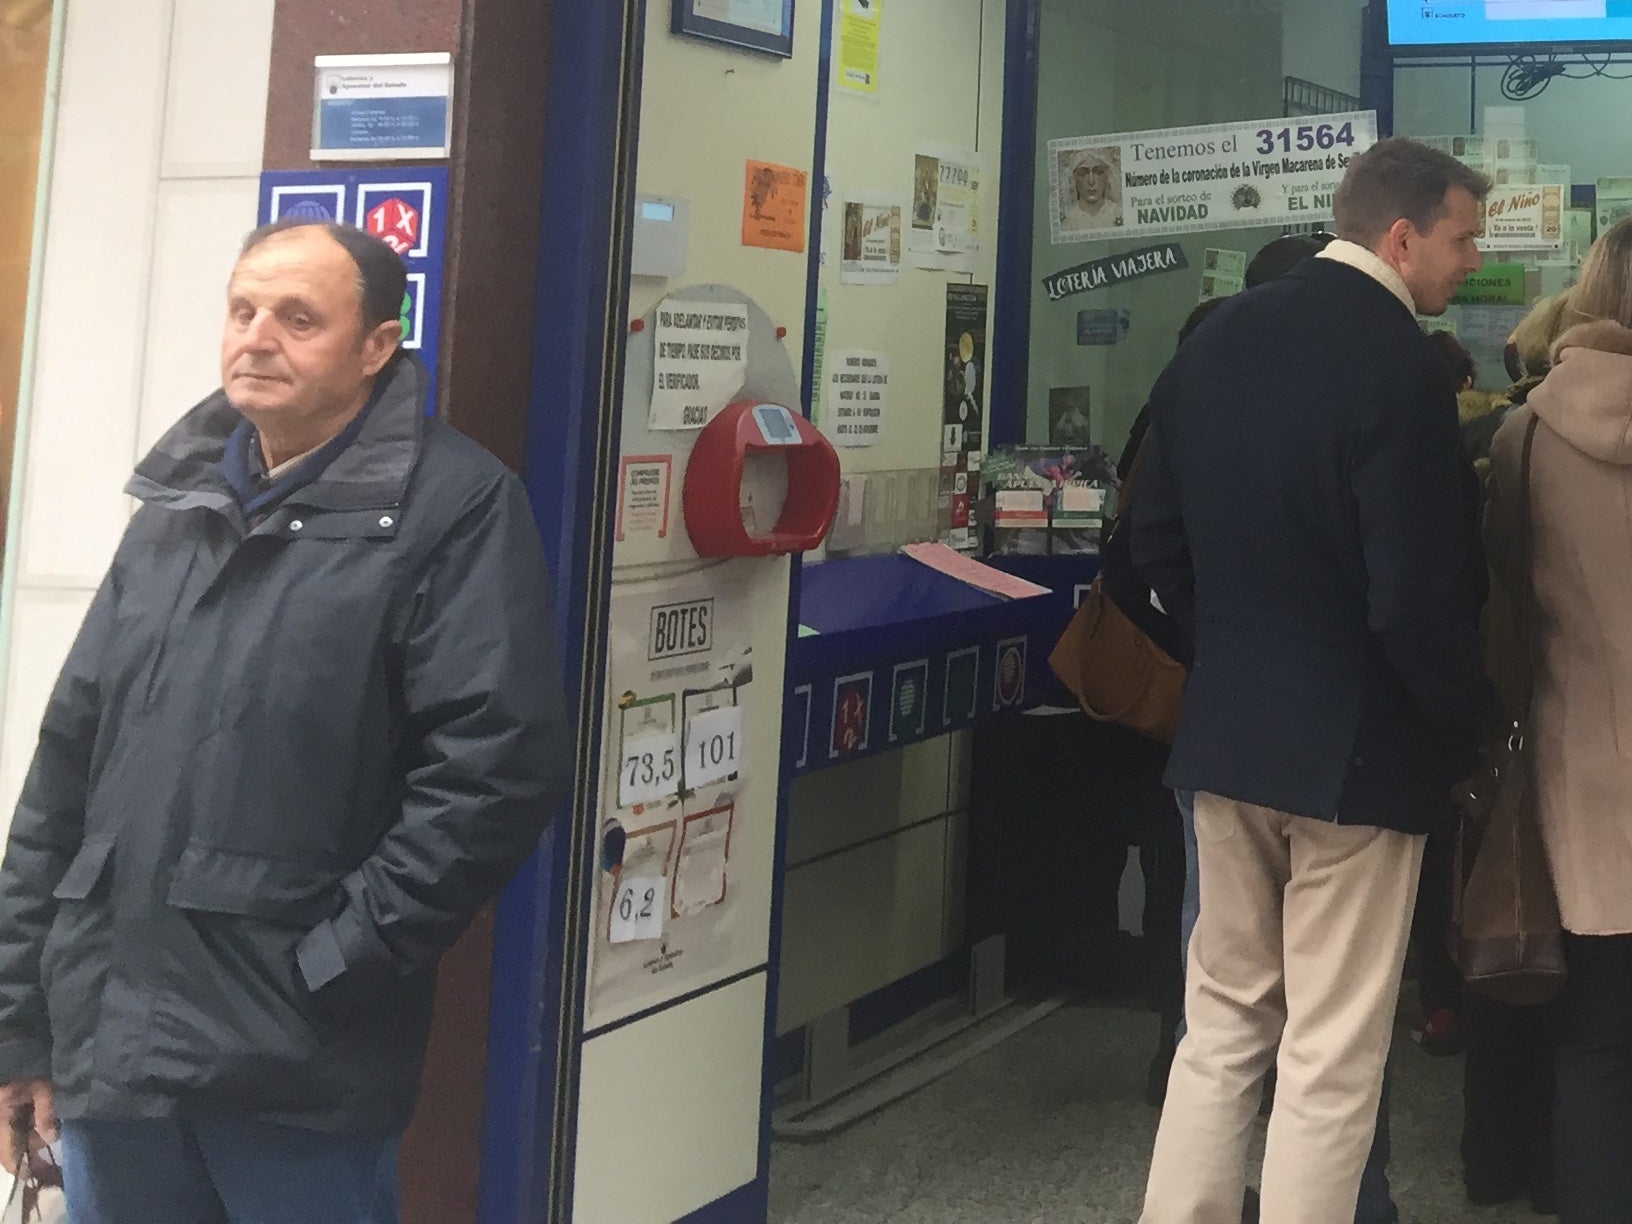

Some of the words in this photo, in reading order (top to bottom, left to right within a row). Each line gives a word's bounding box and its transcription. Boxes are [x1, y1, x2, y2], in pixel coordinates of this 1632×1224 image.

[1130, 142, 1215, 162] Tenemos
[1222, 135, 1237, 153] el
[1256, 122, 1355, 155] 31564
[1159, 169, 1170, 185] de
[1172, 168, 1180, 183] la
[1182, 164, 1228, 182] coronación
[1230, 164, 1240, 178] de
[1242, 162, 1250, 177] la
[1252, 159, 1280, 180] Virgen
[1282, 157, 1324, 175] Macarena
[1325, 154, 1336, 170] de
[1131, 195, 1155, 208] Para
[1156, 194, 1165, 206] el
[1167, 192, 1197, 205] sorteo
[1200, 190, 1212, 202] de
[1288, 197, 1309, 211] EL
[1314, 193, 1334, 209] NI
[1291, 184, 1309, 195] para
[1137, 203, 1209, 225] NAVIDAD
[1049, 264, 1108, 300] LOTERÍA
[1113, 247, 1177, 279] VIAJERA
[655, 606, 708, 654] BOTES
[626, 748, 675, 787] 73,5
[698, 731, 735, 770] 101
